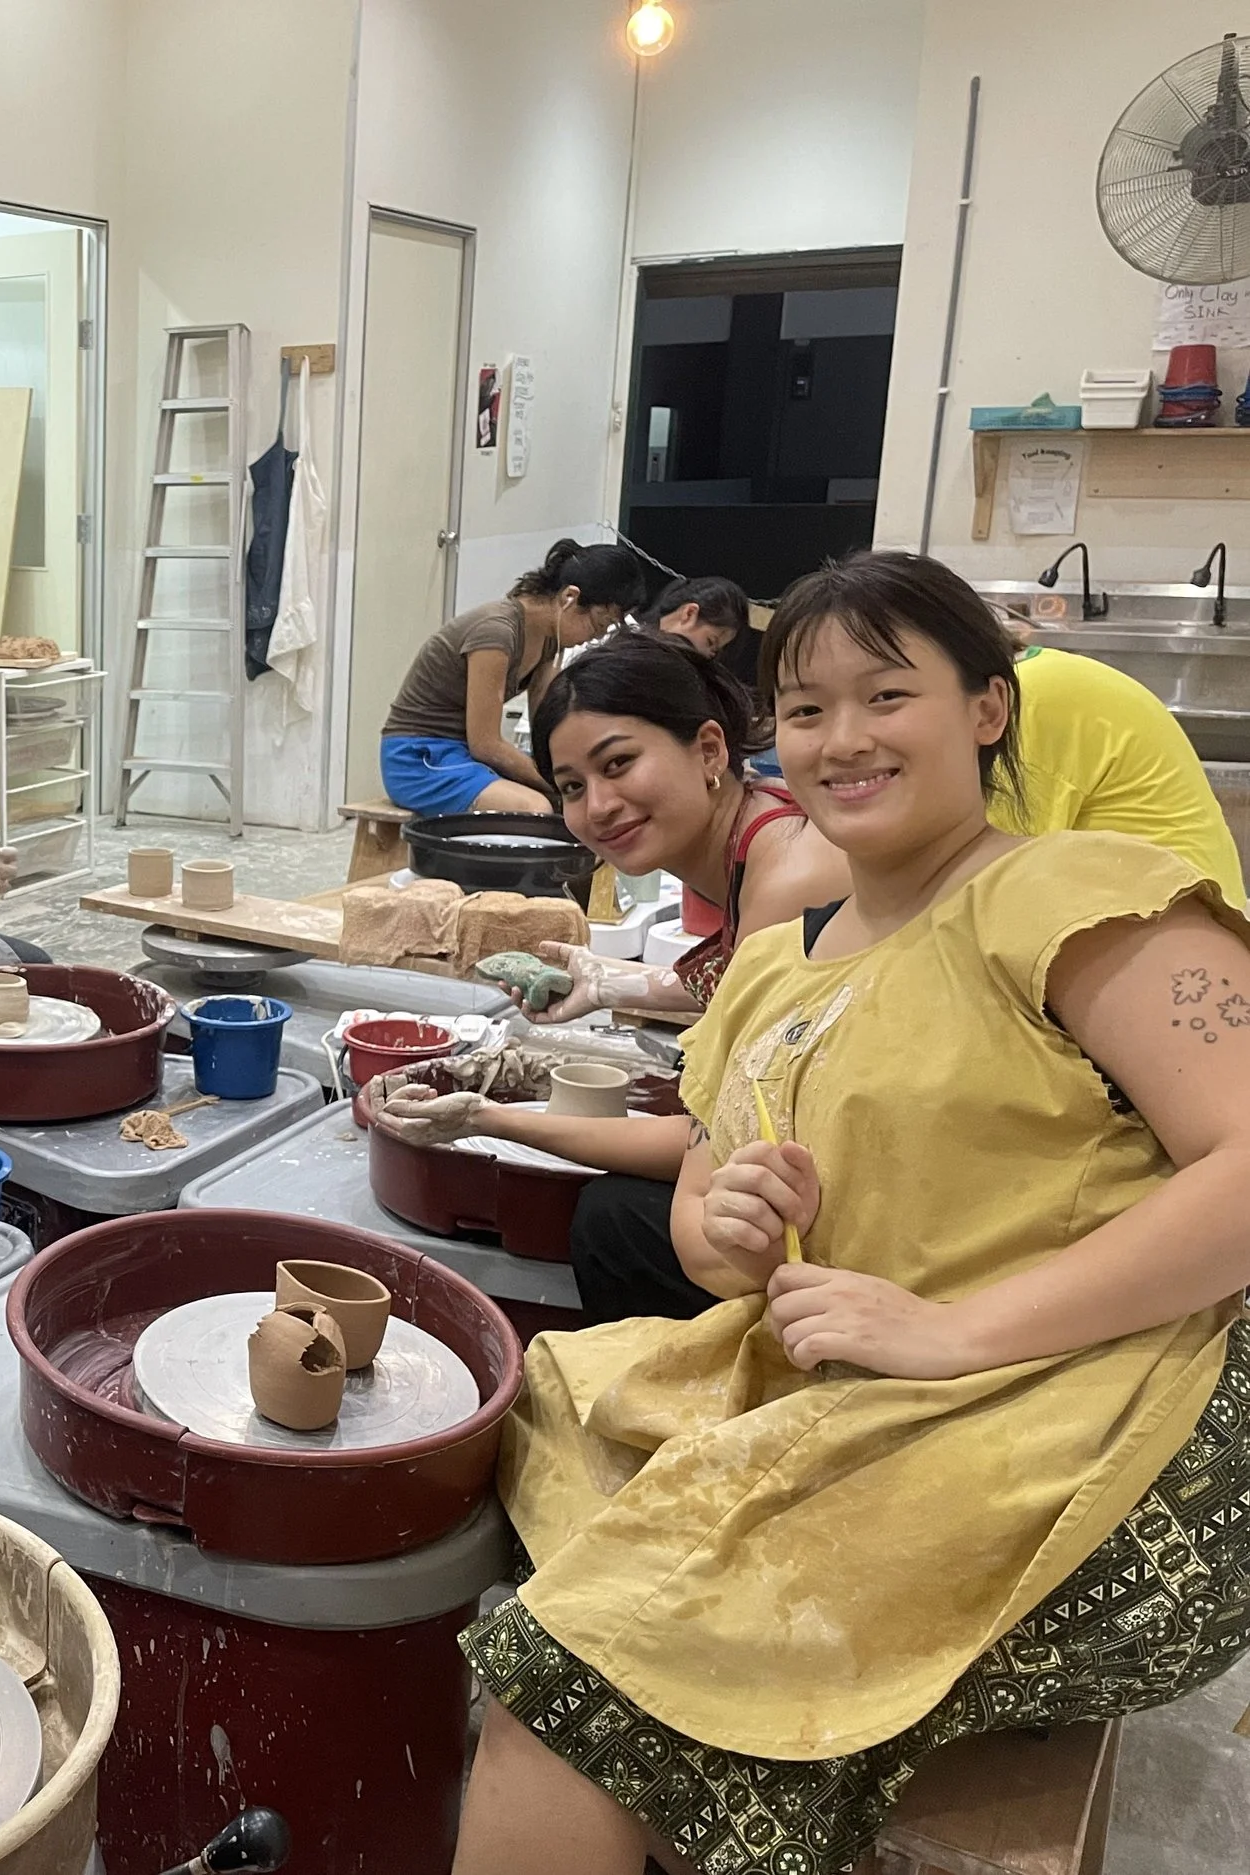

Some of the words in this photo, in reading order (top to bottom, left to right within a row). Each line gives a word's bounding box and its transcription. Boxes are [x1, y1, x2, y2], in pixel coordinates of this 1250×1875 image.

[1164, 284, 1194, 304] Only
[1200, 286, 1239, 306] Clay
[1183, 305, 1230, 320] SINK
